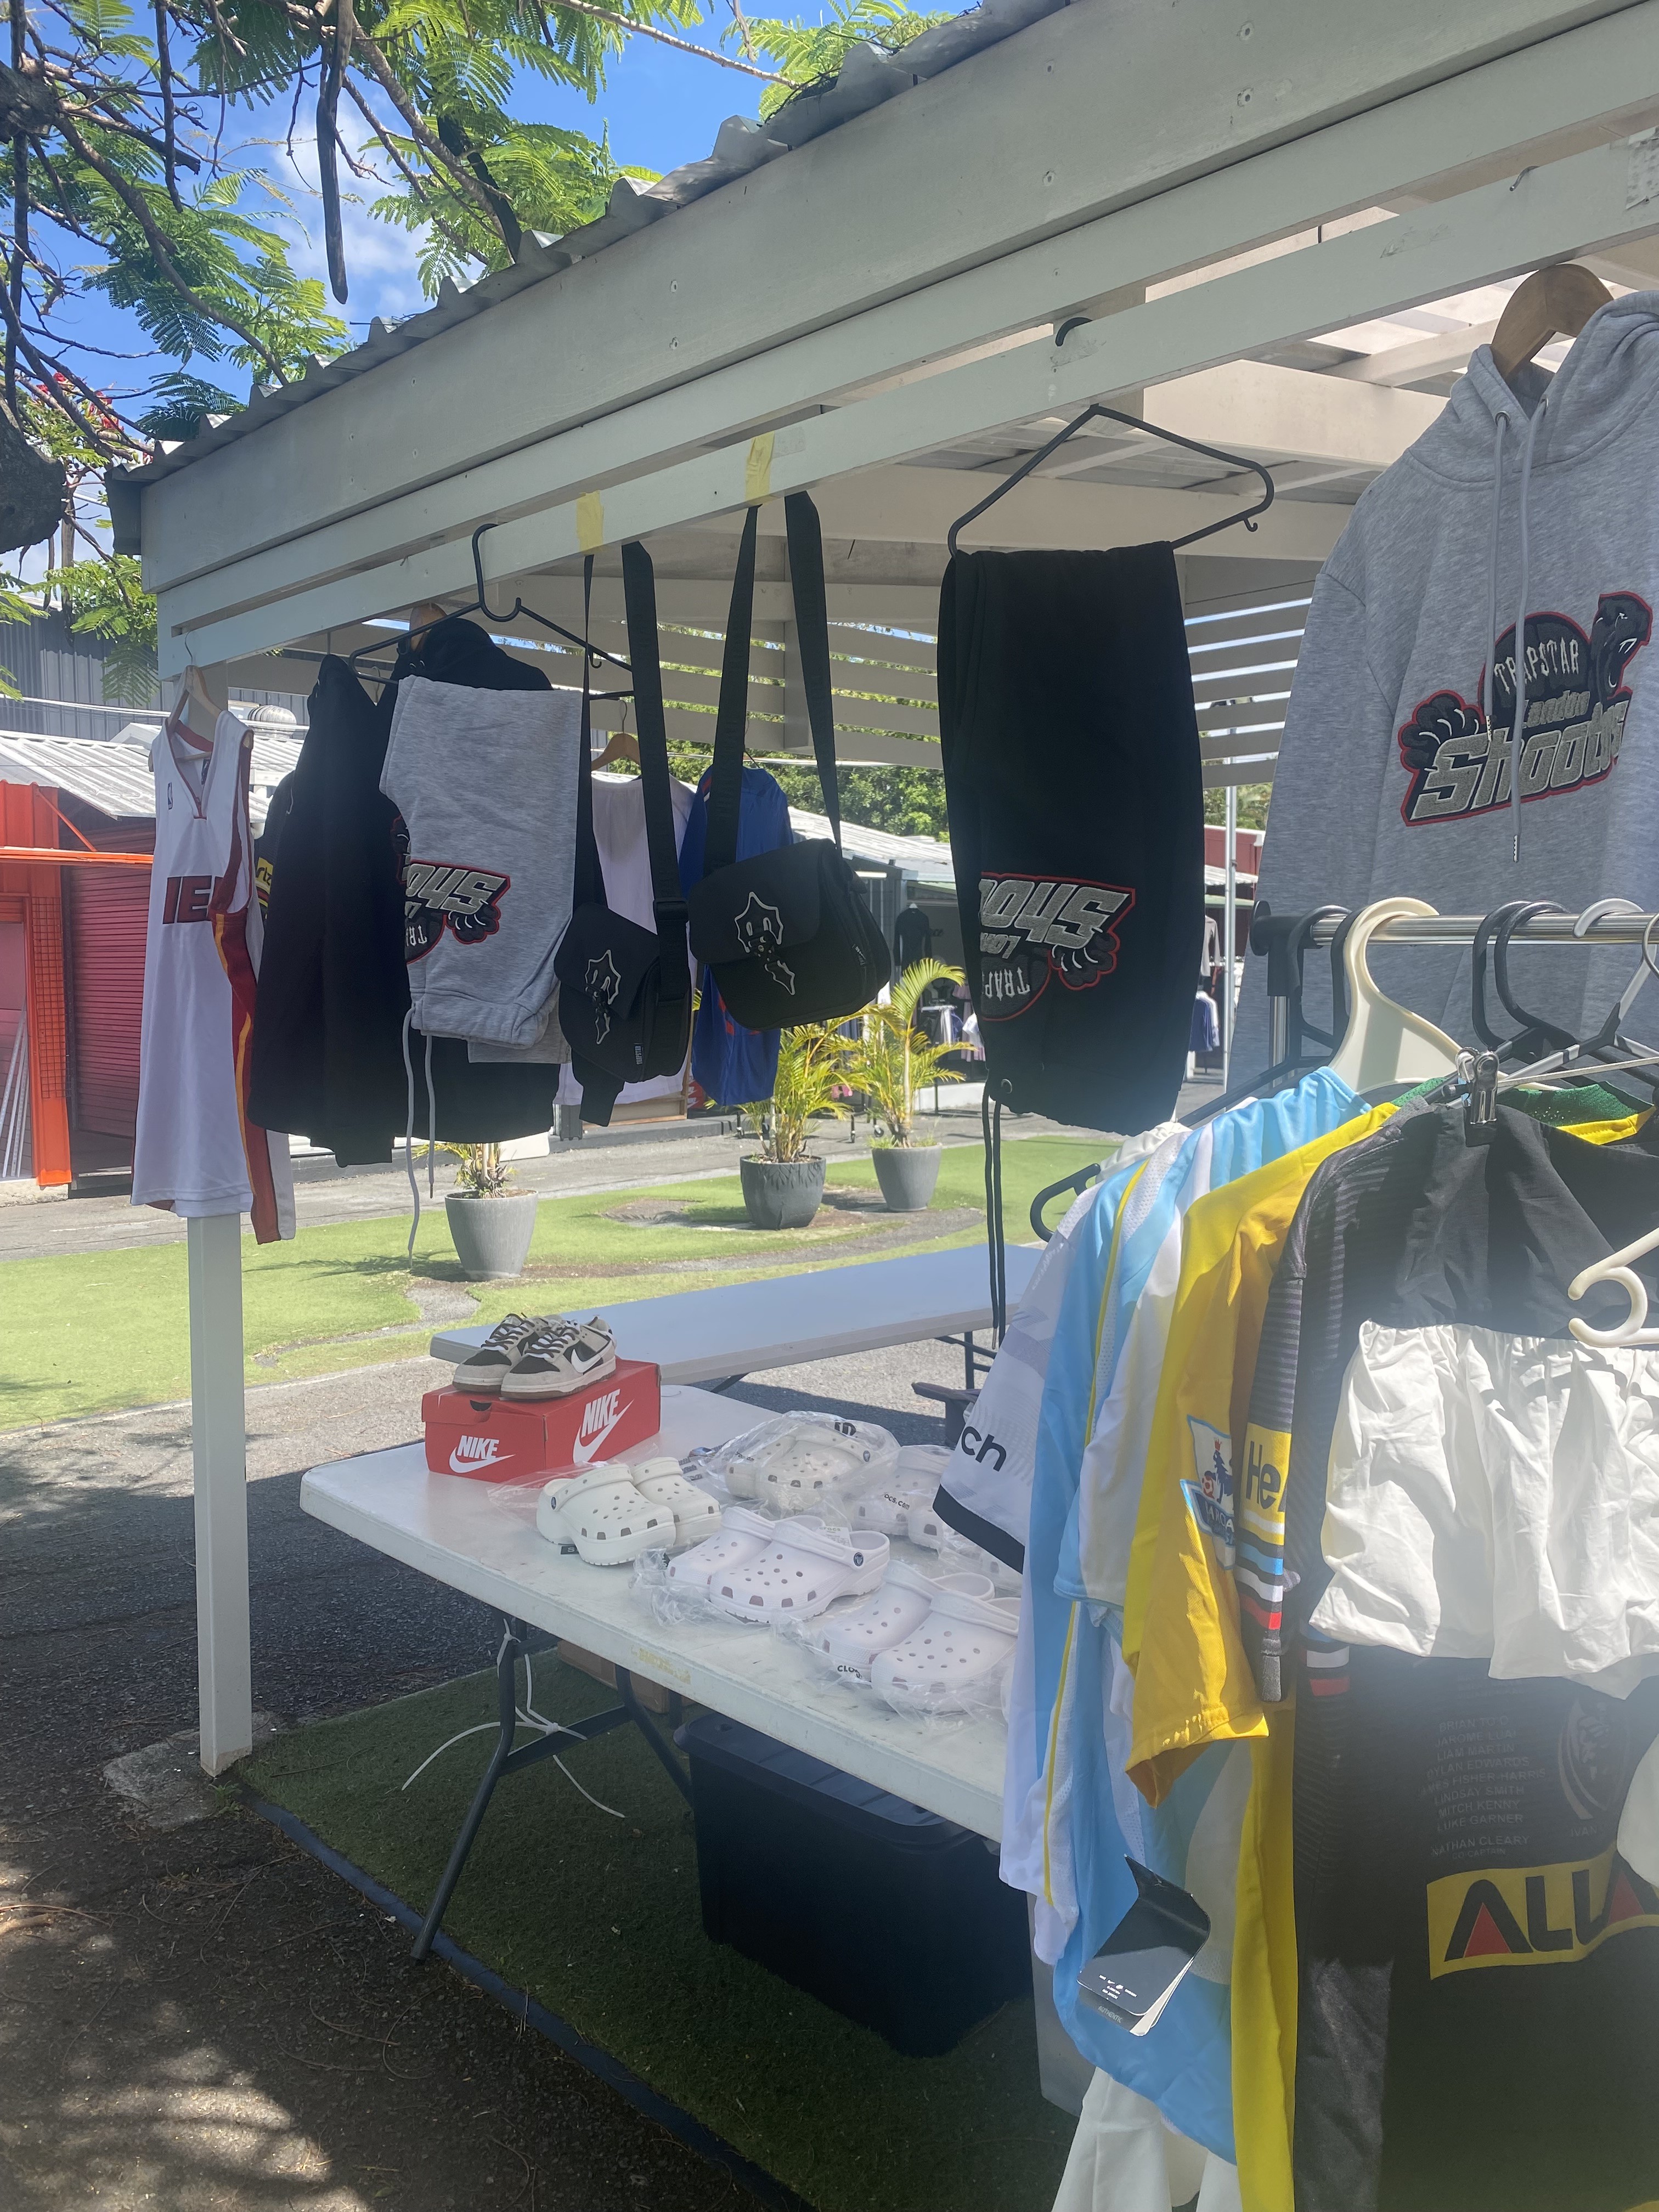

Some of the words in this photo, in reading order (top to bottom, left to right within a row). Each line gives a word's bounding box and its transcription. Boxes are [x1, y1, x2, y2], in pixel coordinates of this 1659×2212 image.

[982, 966, 1030, 1001] TRAP
[581, 1389, 620, 1437] NIKE
[457, 1435, 500, 1460] NIKE
[1439, 1719, 1475, 1732] BRIAN
[1435, 1731, 1483, 1748] JAROME
[1437, 1748, 1464, 1762] LIAM
[1469, 1743, 1514, 1756] MARTIN
[1468, 1756, 1530, 1769] EDWARDS
[1434, 1787, 1481, 1806] LINDSAY
[1486, 1786, 1525, 1796] SMITH
[1438, 1801, 1472, 1818] MITCH
[1477, 1799, 1521, 1810] KENNY
[1437, 1817, 1466, 1832] LUKE
[1470, 1814, 1523, 1825] GARNER
[1431, 1838, 1475, 1857] NATHAN
[1479, 1836, 1530, 1846] CLEARY
[1098, 2006, 1123, 2023] AUTHENTIC
